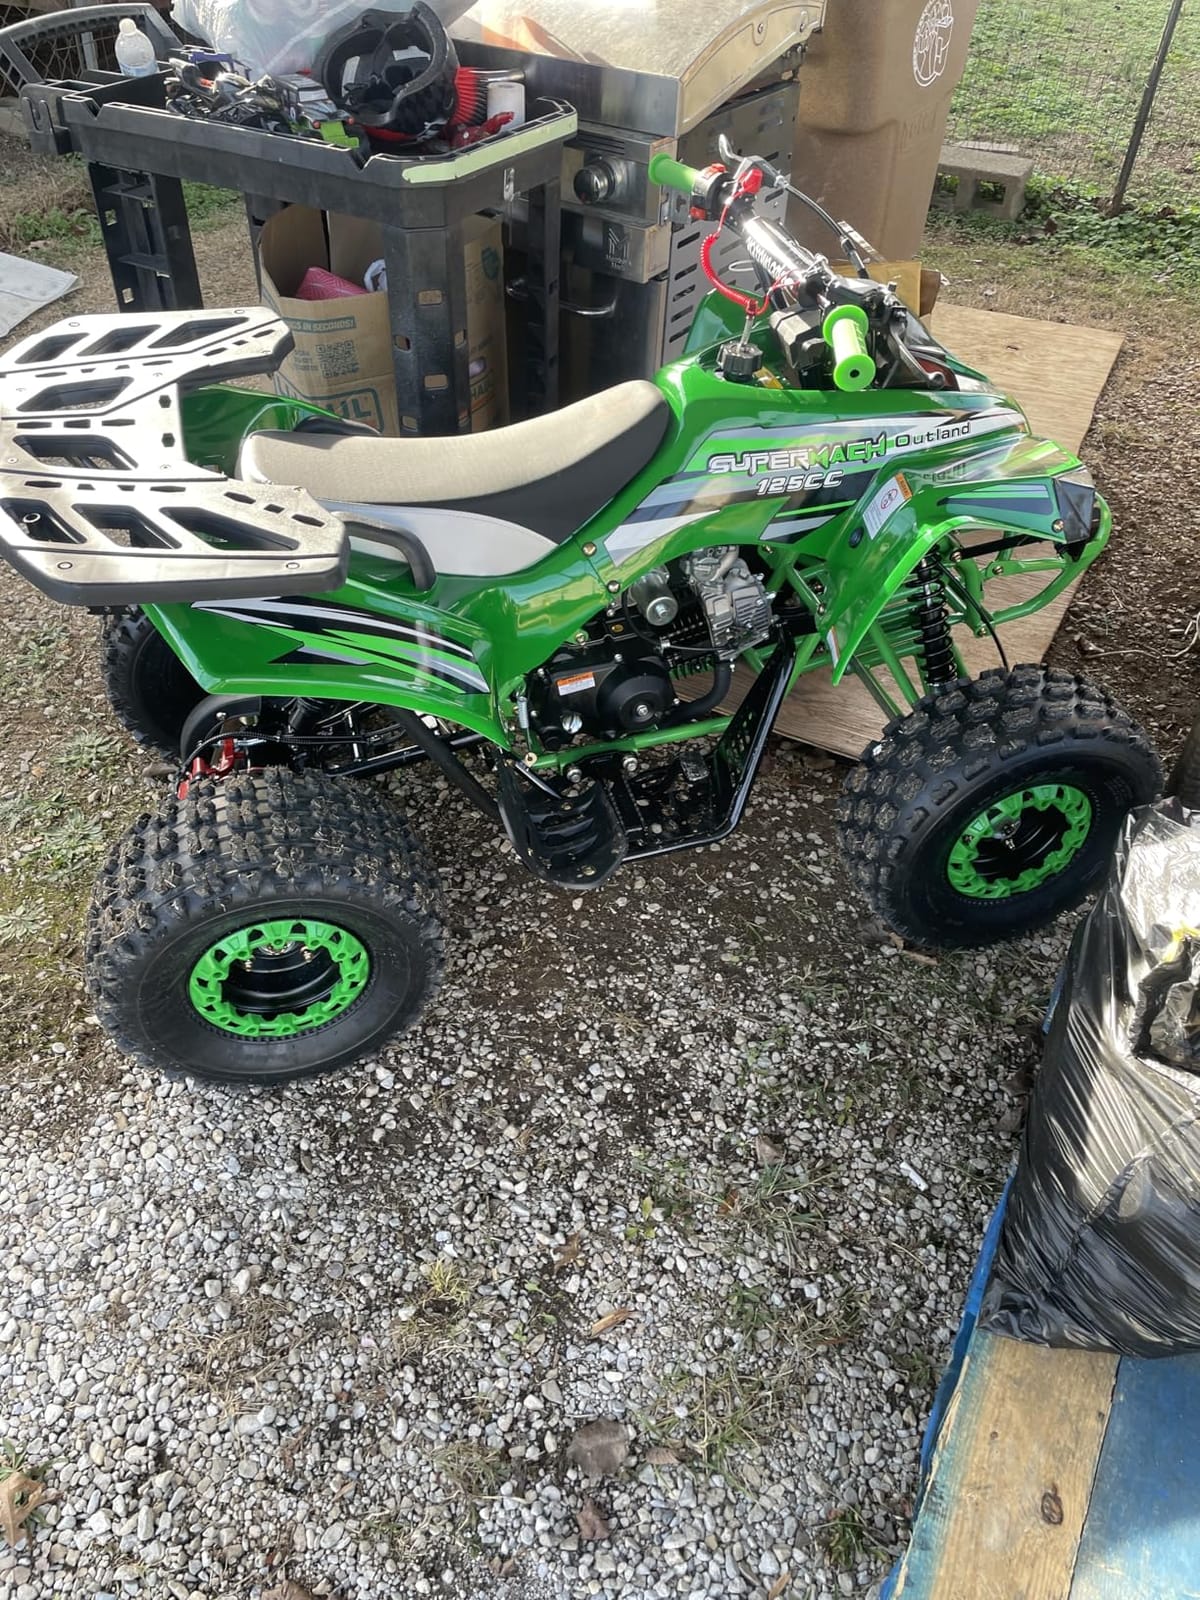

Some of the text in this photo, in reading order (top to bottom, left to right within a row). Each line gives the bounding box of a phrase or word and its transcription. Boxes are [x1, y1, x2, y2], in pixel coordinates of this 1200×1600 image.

[708, 432, 887, 475] SUPERMACH
[895, 422, 970, 447] Outland
[756, 470, 844, 496] 125CC
